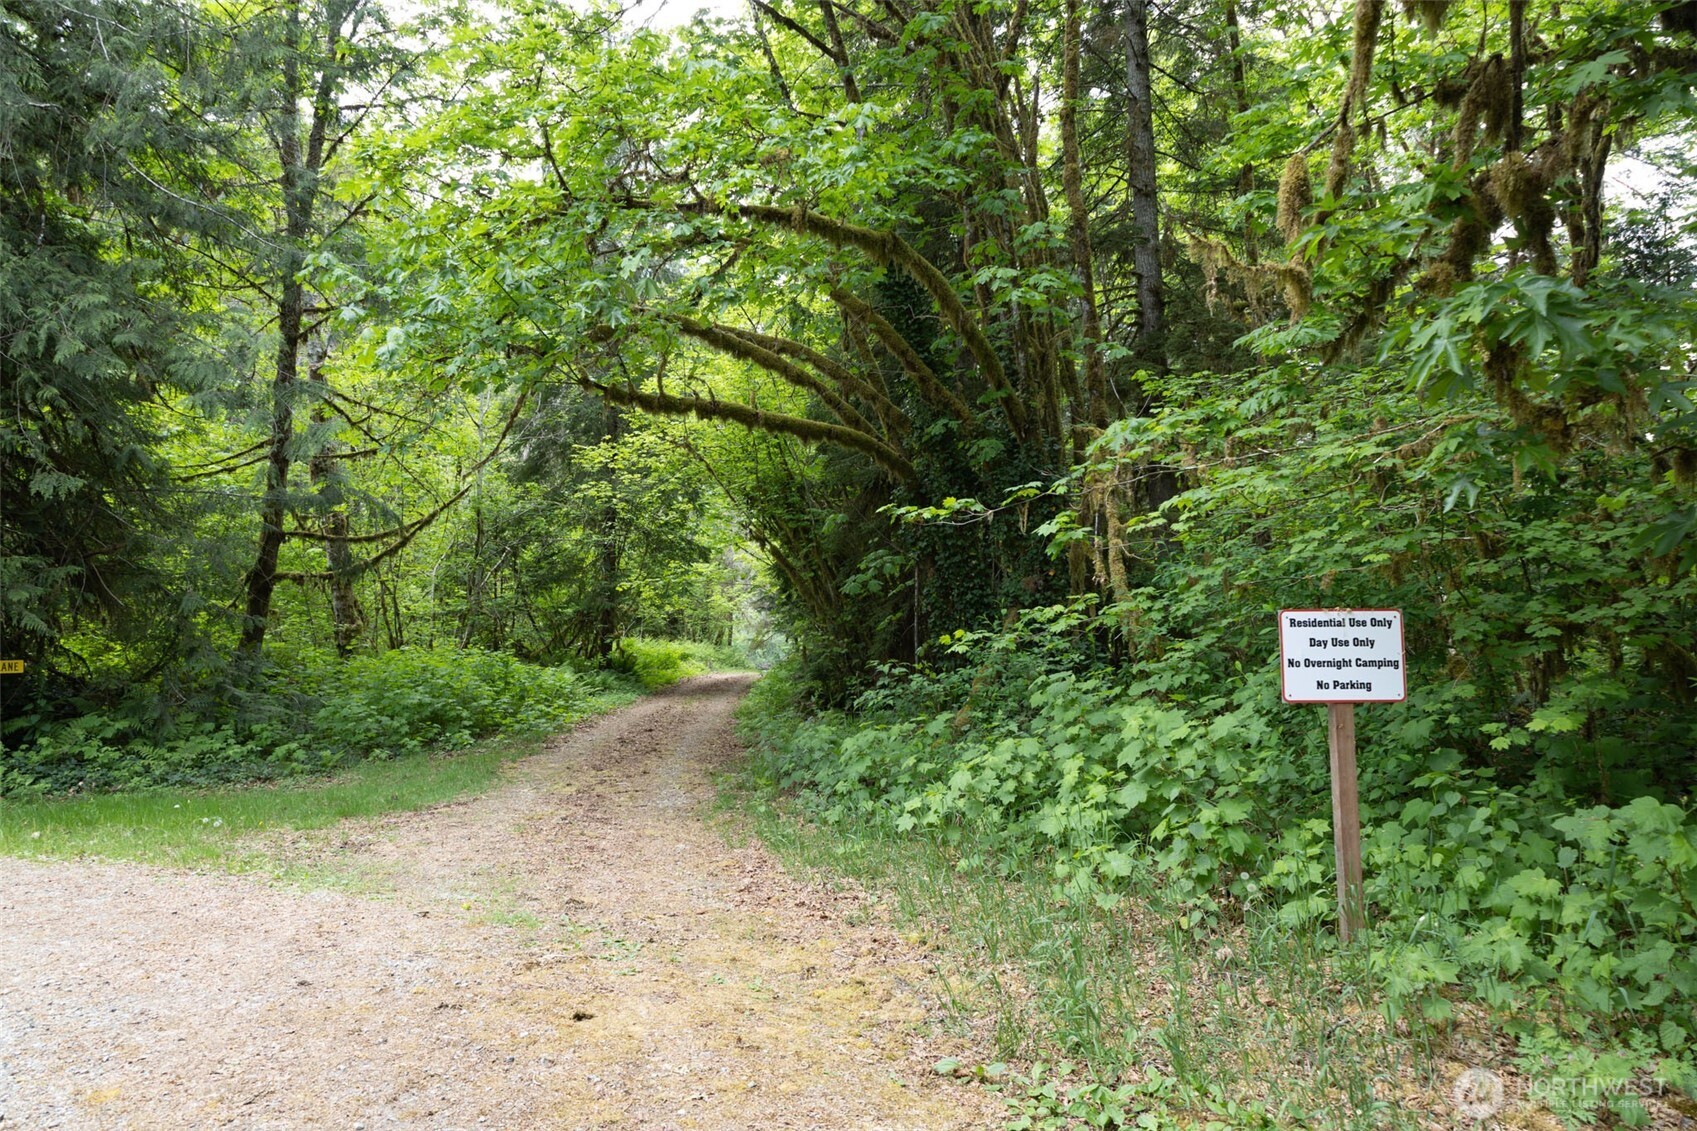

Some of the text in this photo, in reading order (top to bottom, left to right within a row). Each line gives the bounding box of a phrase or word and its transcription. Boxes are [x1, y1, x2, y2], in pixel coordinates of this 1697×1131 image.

[1289, 617, 1393, 629] Residential Use Only
[1309, 637, 1375, 649] Day Use Only
[1287, 658, 1400, 670] No Overnight Camping
[1316, 680, 1372, 692] No Parking
